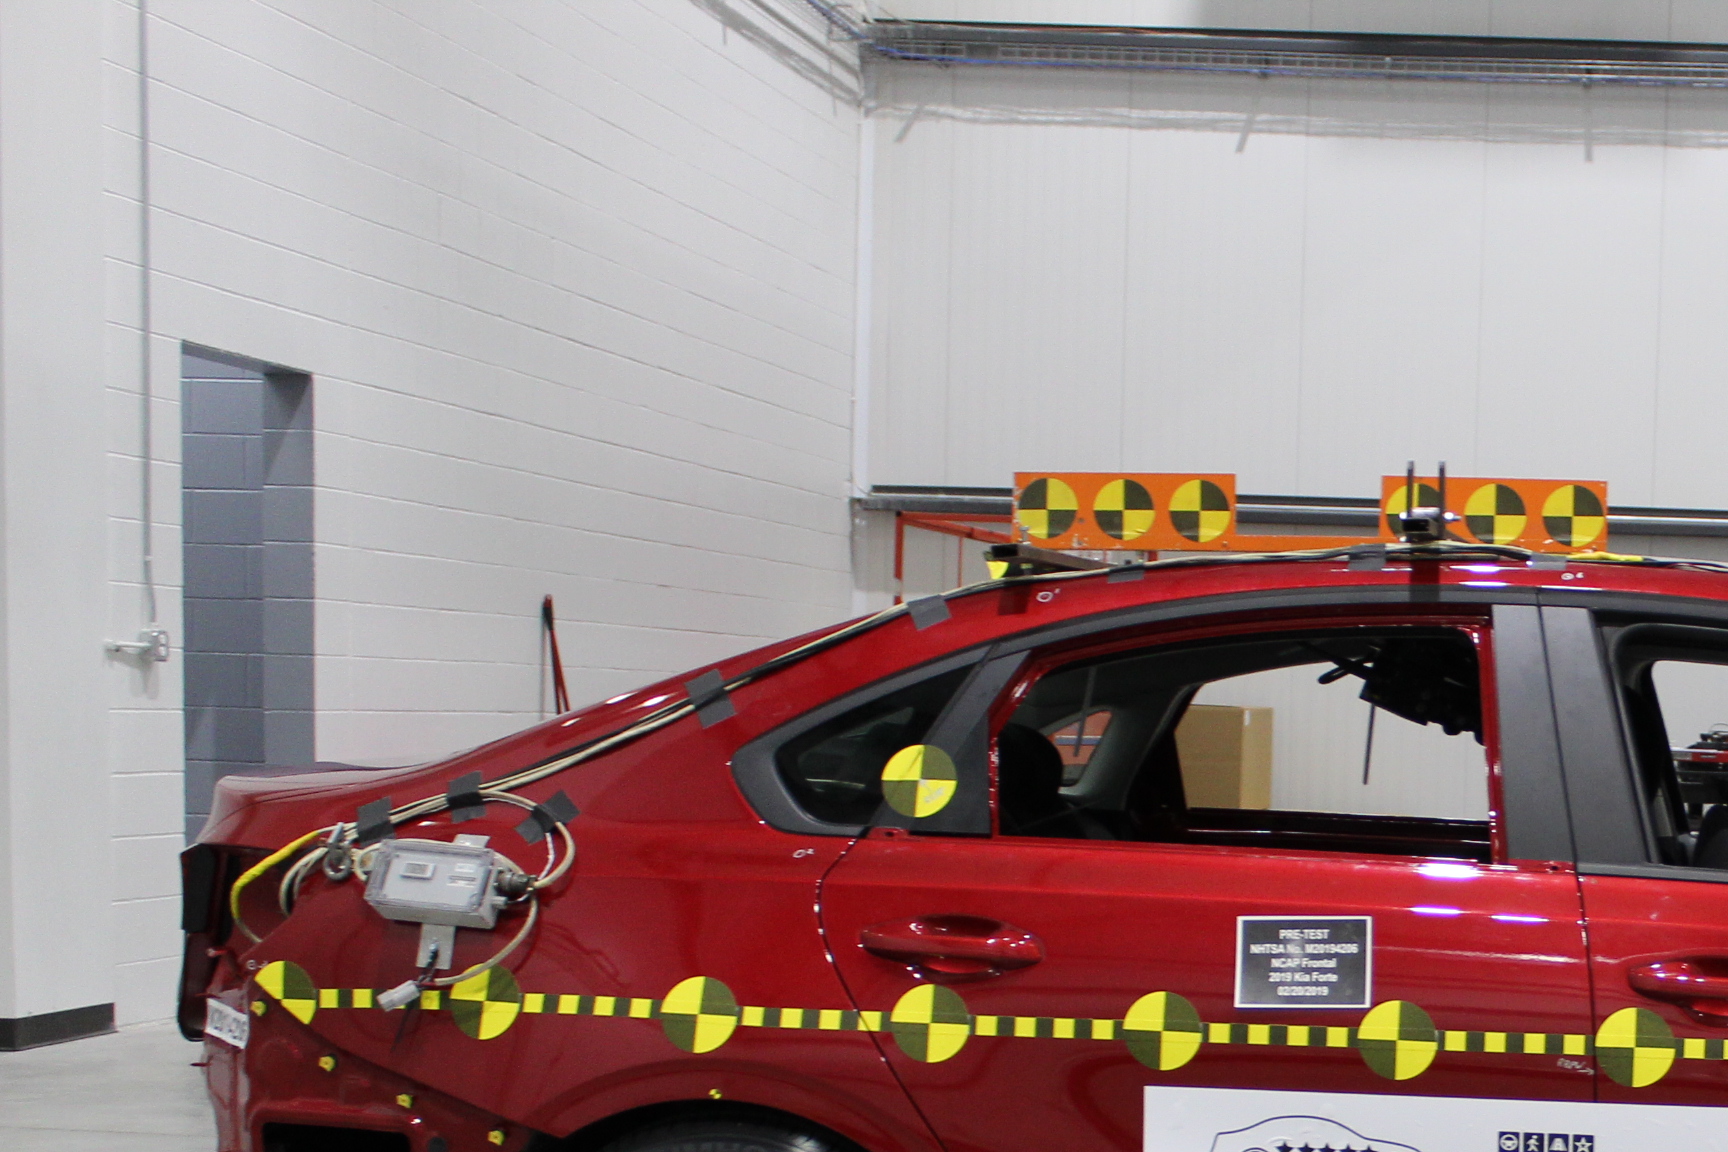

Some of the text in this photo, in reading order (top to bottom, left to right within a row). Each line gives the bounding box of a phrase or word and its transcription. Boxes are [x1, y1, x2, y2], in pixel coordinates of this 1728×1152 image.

[1278, 928, 1330, 940] PRE-TEST
[1249, 943, 1285, 954] NHTSA
[1305, 943, 1359, 954] M20194206
[1270, 958, 1337, 968] NCAP Frontal
[1268, 972, 1338, 982] 2019 Kia Forte
[1276, 985, 1329, 996] 02/20/2019
